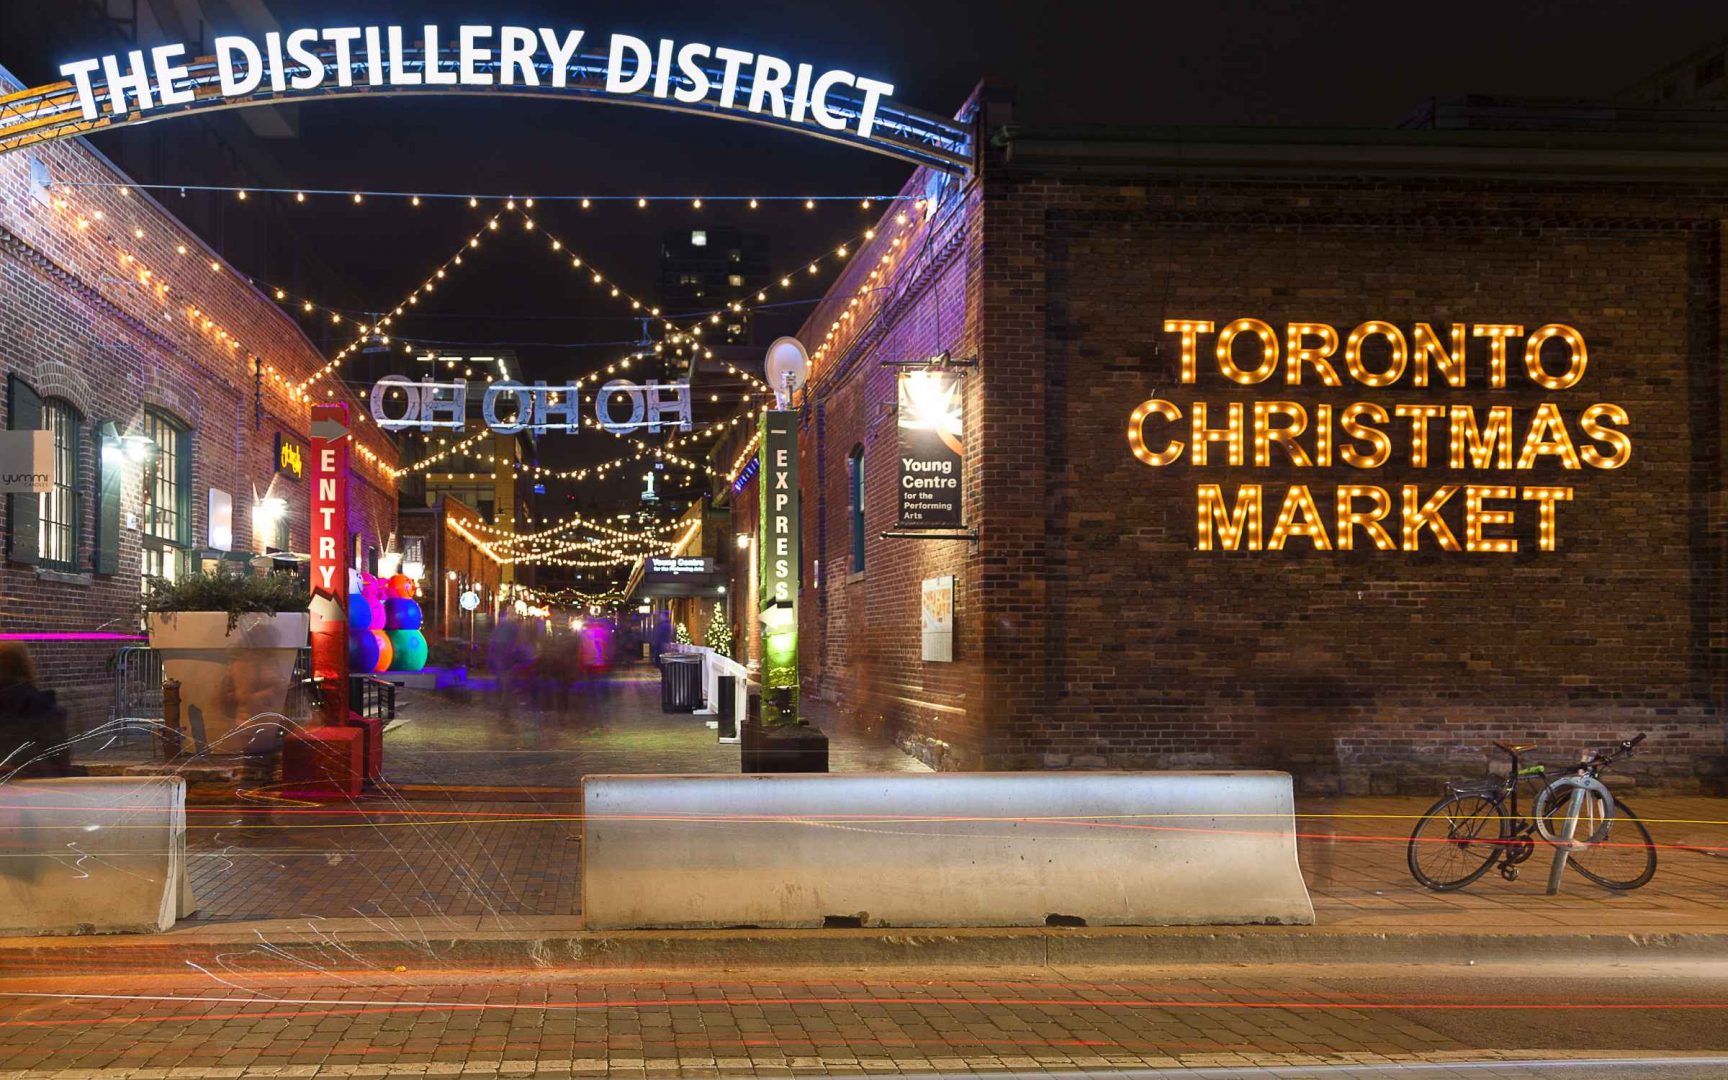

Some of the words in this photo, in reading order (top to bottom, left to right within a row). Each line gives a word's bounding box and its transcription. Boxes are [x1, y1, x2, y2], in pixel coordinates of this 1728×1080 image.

[59, 43, 196, 120] THE
[214, 25, 586, 96] DISTILLERY
[606, 34, 895, 138] DISTRICT
[1163, 318, 1589, 390] TORONTO
[1127, 398, 1633, 471] CHRISTMAS
[3, 474, 48, 485] yummi
[902, 458, 952, 474] Young
[902, 475, 957, 489] Centre
[904, 492, 917, 500] for
[919, 492, 934, 500] the
[904, 502, 953, 511] Performing
[904, 512, 923, 520] Arts
[319, 449, 338, 588] ENTRY
[775, 449, 789, 600] EXPRESS
[1197, 483, 1575, 553] MARKET
